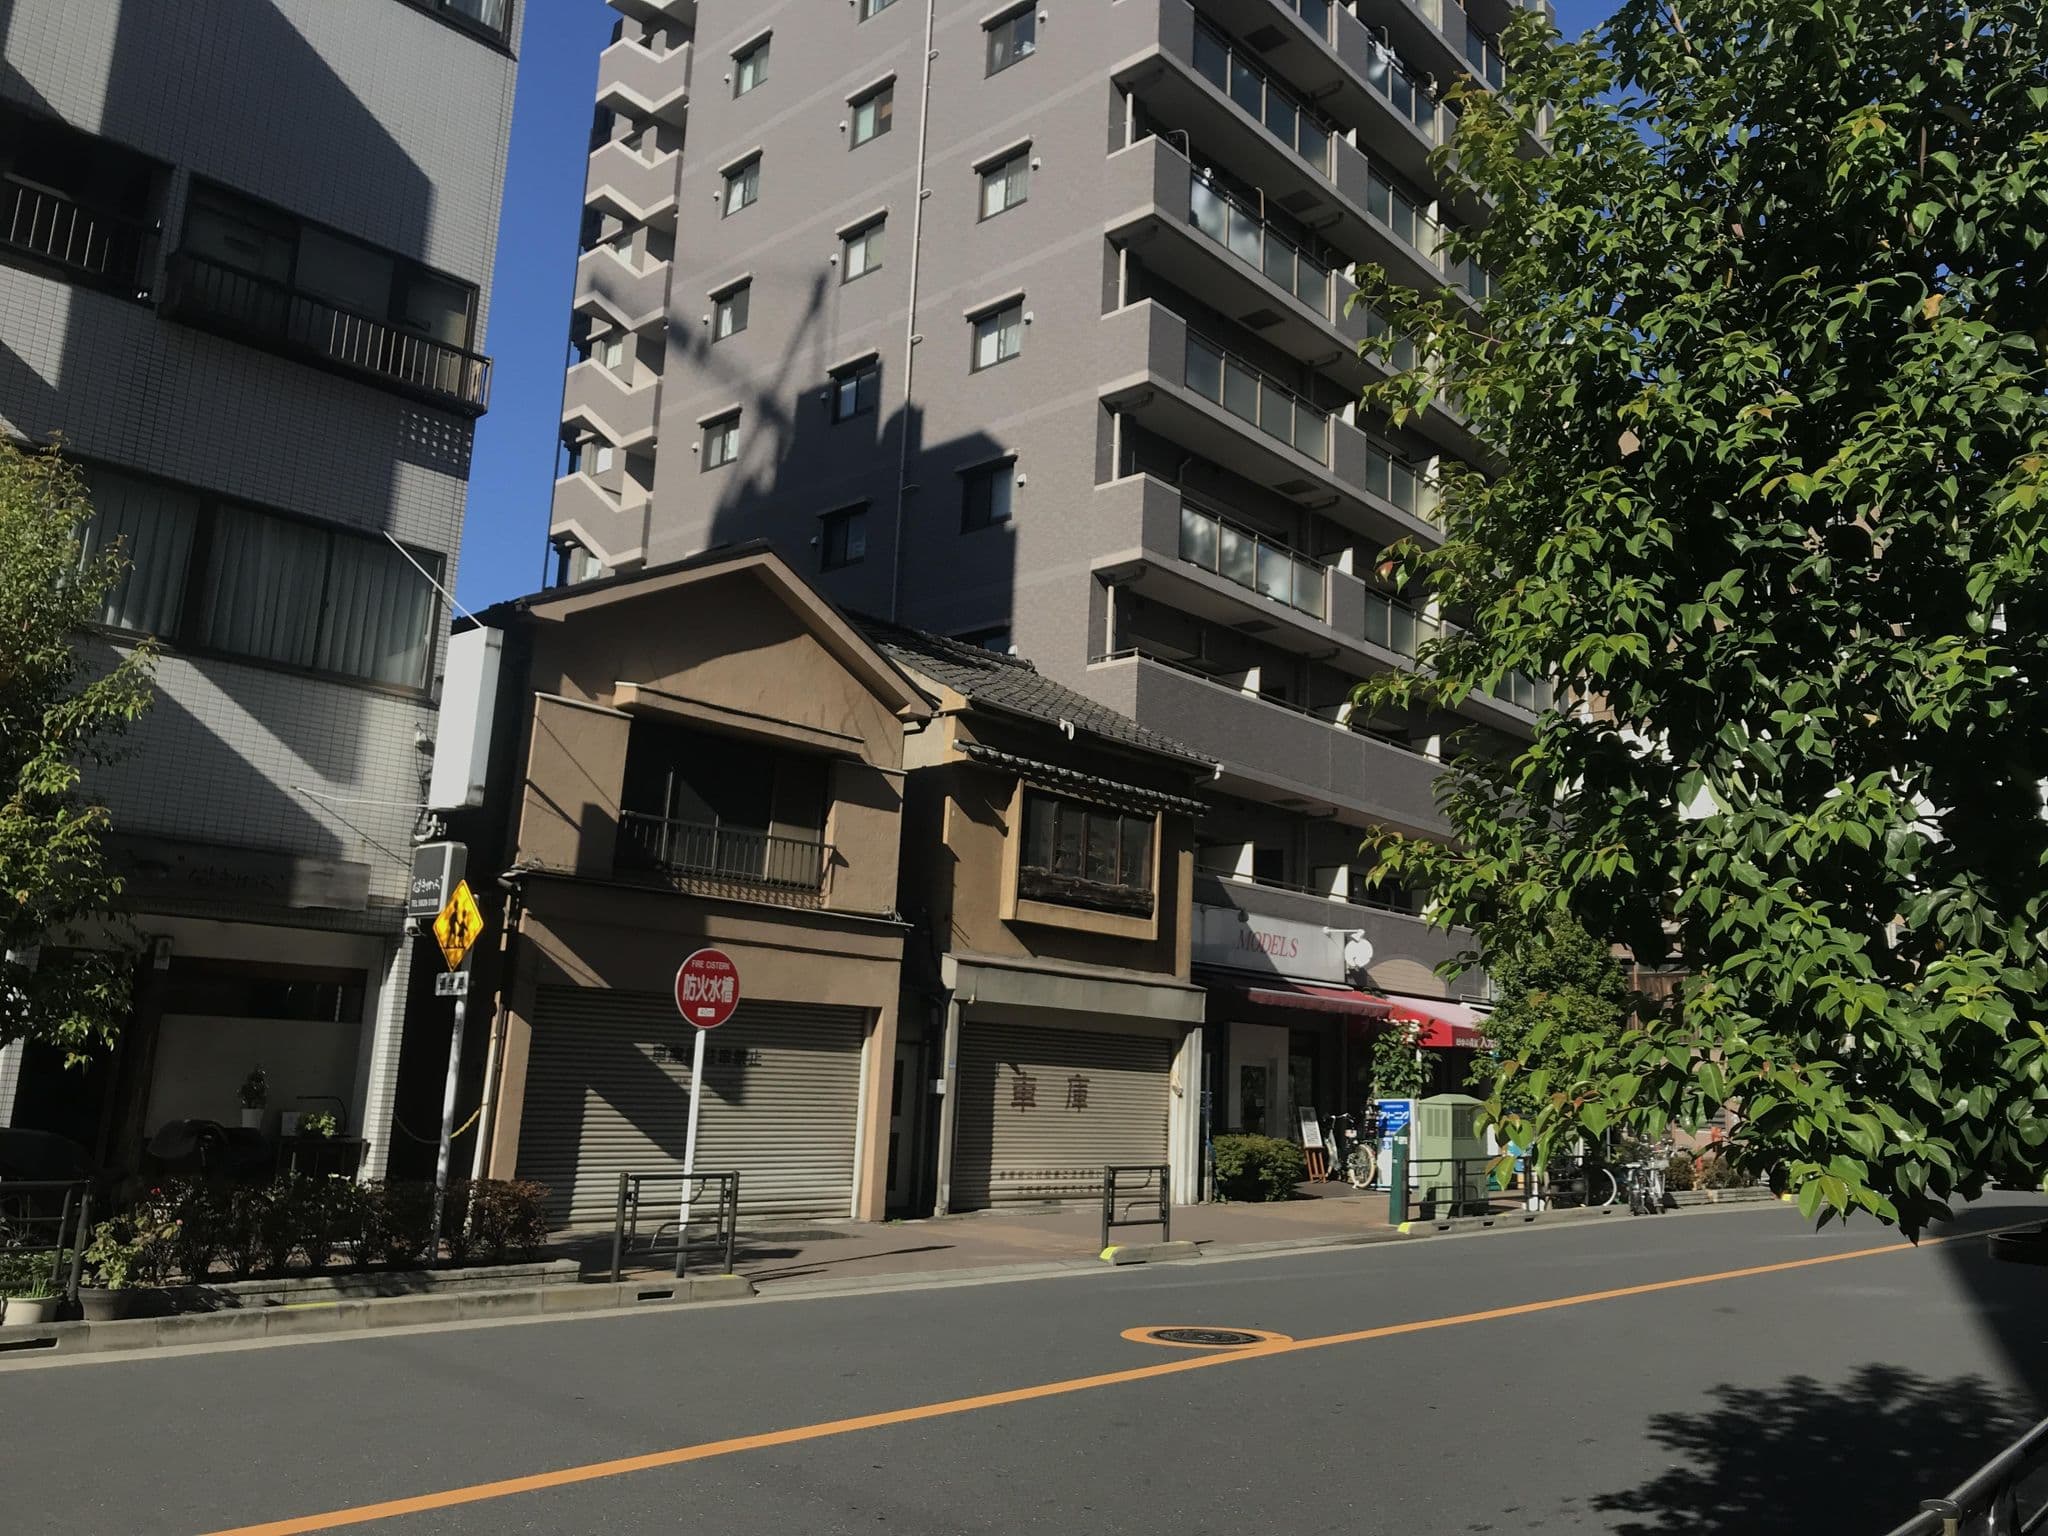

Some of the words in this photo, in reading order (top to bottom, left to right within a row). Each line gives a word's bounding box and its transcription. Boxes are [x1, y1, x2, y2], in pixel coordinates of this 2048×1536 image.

[1236, 929, 1299, 958] MODELS
[691, 959, 705, 968] FIRE
[706, 960, 730, 970] CISTERN
[682, 973, 735, 1003] 防火水槽
